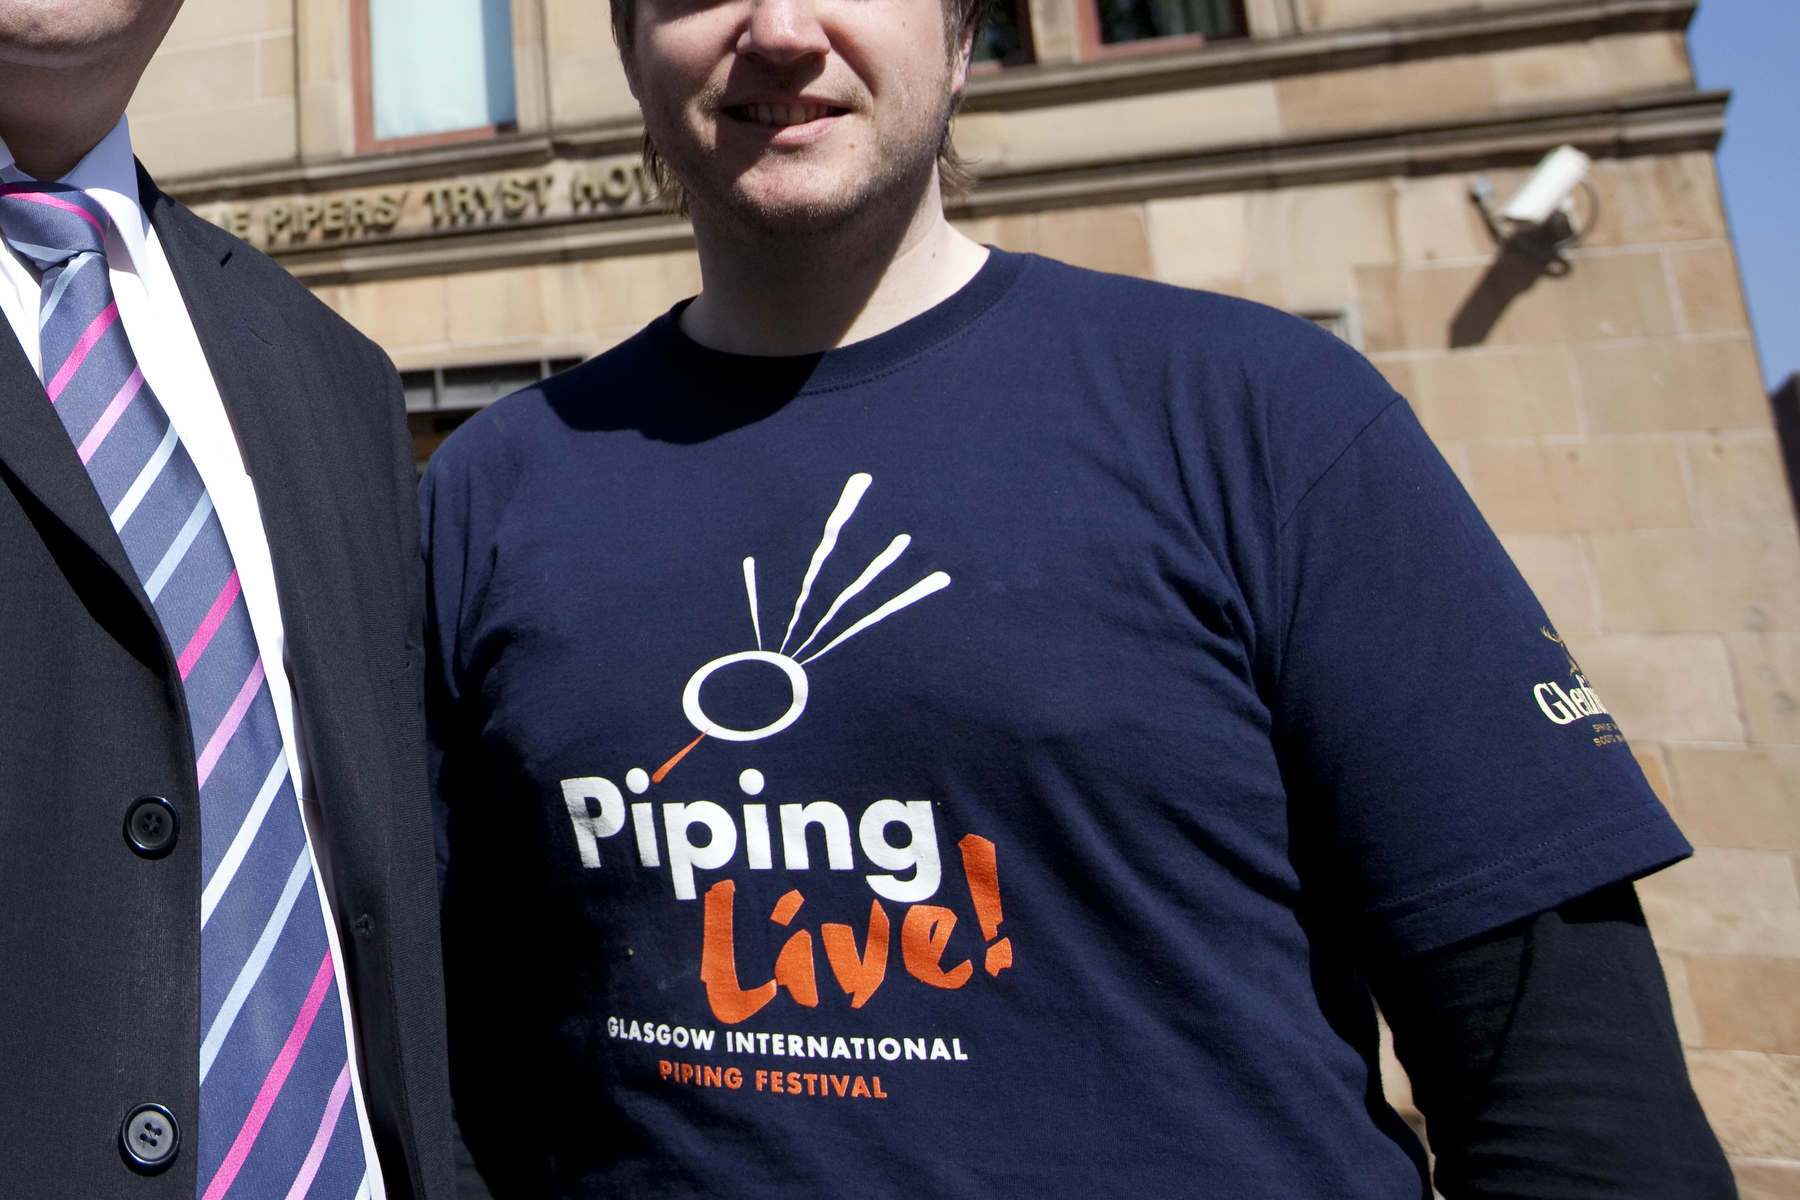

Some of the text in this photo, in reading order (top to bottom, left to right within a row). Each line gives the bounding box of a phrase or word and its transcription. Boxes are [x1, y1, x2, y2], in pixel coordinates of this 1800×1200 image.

[426, 172, 553, 227] TRYST
[560, 767, 942, 903] Piping
[700, 833, 1014, 1025] Live!
[607, 1016, 969, 1062] GLASGOW INTERNATIONAL
[658, 1059, 888, 1099] PIPING FESTIVAL
